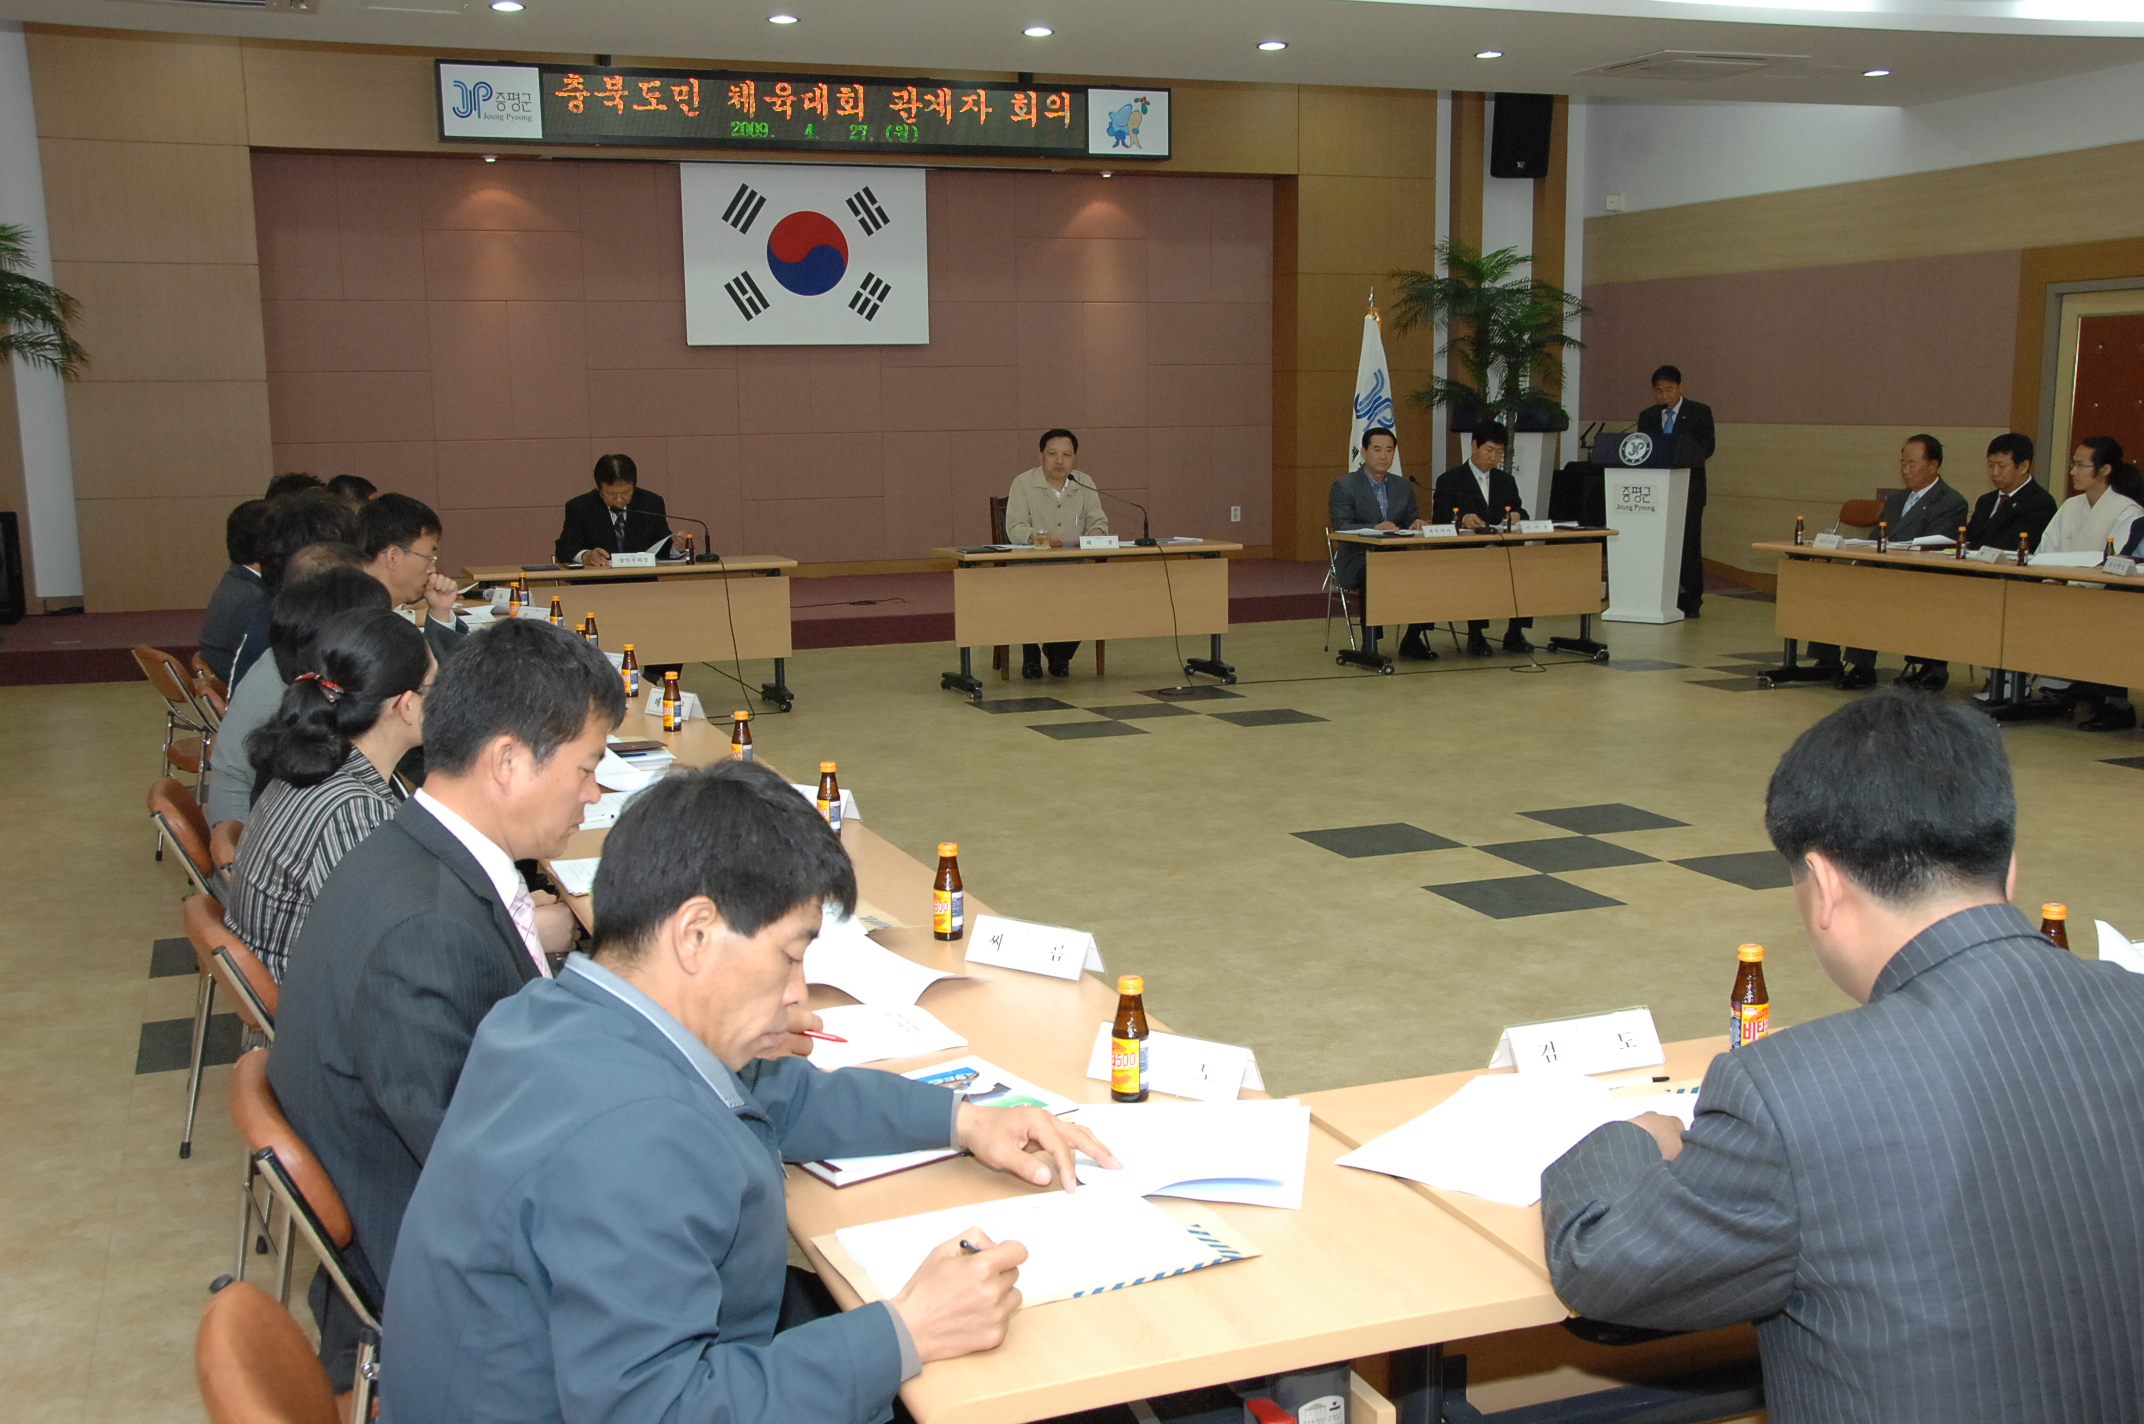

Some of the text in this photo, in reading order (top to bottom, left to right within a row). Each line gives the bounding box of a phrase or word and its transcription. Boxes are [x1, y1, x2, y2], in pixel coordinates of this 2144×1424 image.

[495, 92, 532, 112] 증평군
[555, 73, 1071, 129] 충북도민 체육대회 관계자 회의
[483, 112, 532, 122] Jeung Pyeong
[731, 121, 775, 138] 2009.
[849, 124, 874, 142] 27.
[1622, 486, 1651, 503] 증평군
[1617, 1031, 1638, 1050] 도
